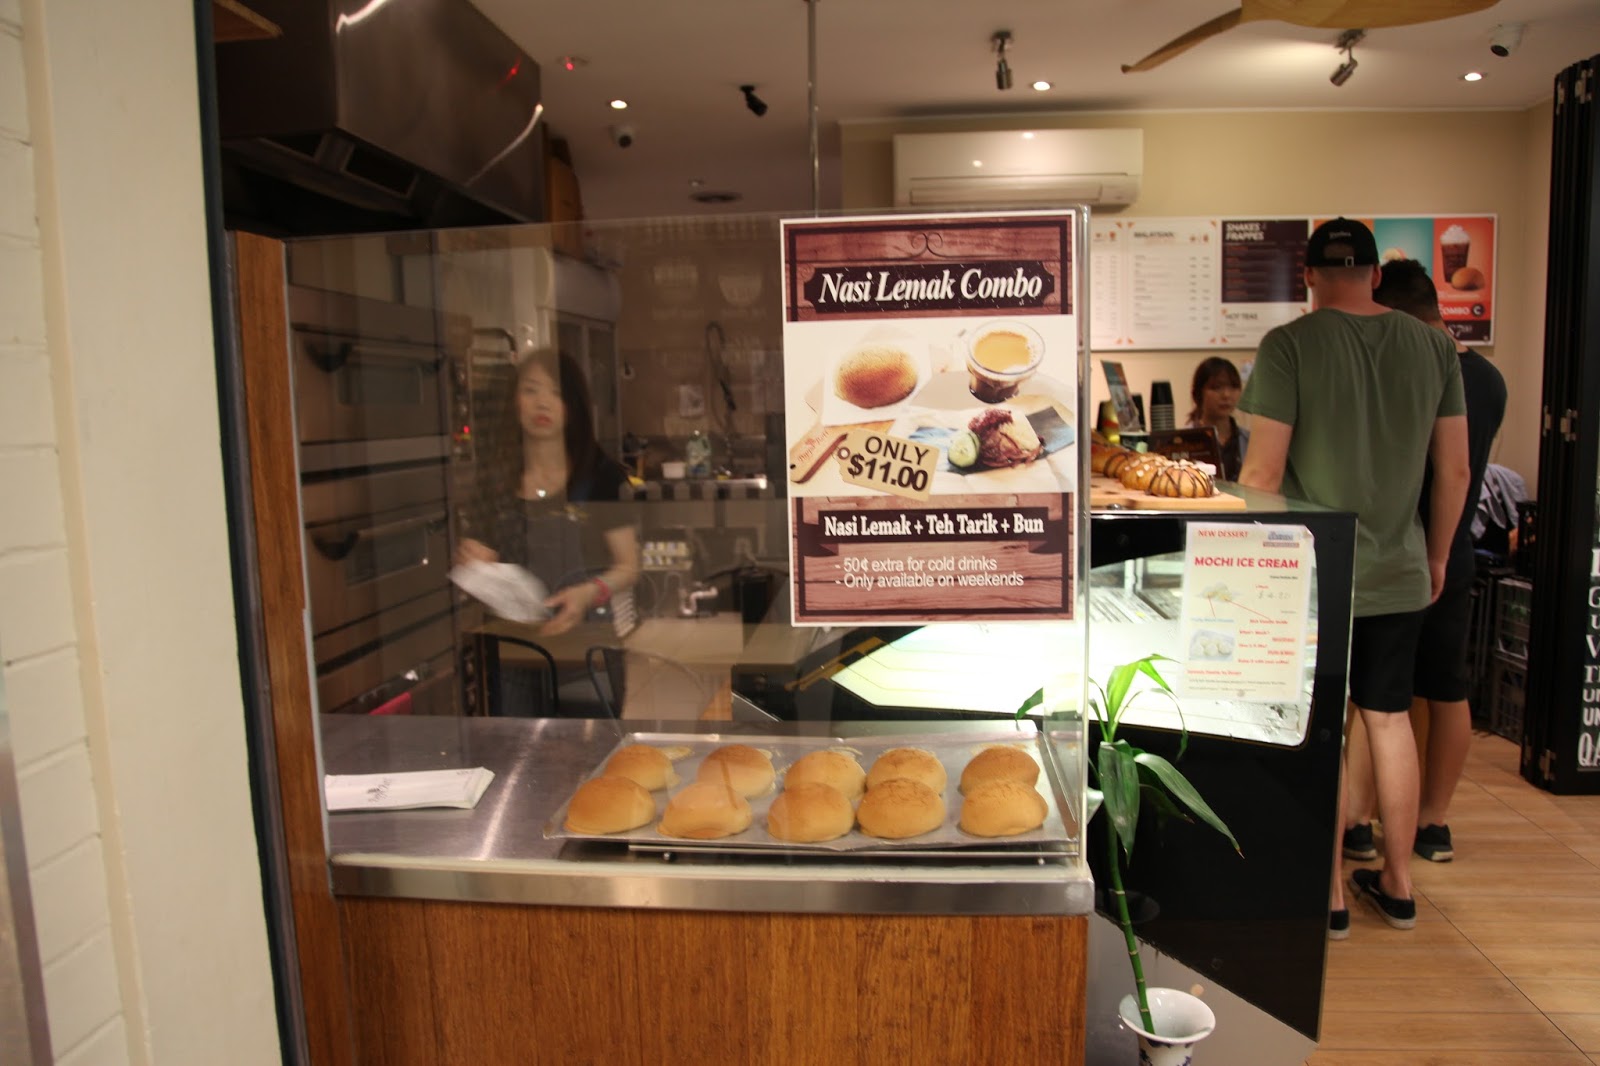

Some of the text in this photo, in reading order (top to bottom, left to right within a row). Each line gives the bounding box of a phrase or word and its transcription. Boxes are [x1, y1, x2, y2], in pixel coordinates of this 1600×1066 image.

[1226, 222, 1260, 231] SHAKES
[818, 267, 1042, 303] Nasi Lemak Combo
[865, 436, 929, 466] ONLY
[847, 453, 929, 491] $11.00
[824, 512, 1044, 536] Nasi Lemak + Teh Tarik + Bun
[1198, 530, 1215, 538] NEW
[843, 556, 869, 573] 50¢
[871, 557, 904, 572] extra
[907, 556, 925, 572] for
[928, 556, 955, 571] cold
[958, 555, 998, 570] drinks
[1194, 556, 1299, 569] MOCHI ICE CREAM
[843, 572, 875, 591] Only
[877, 572, 935, 587] available
[937, 576, 955, 587] on
[957, 570, 1024, 587] weekends
